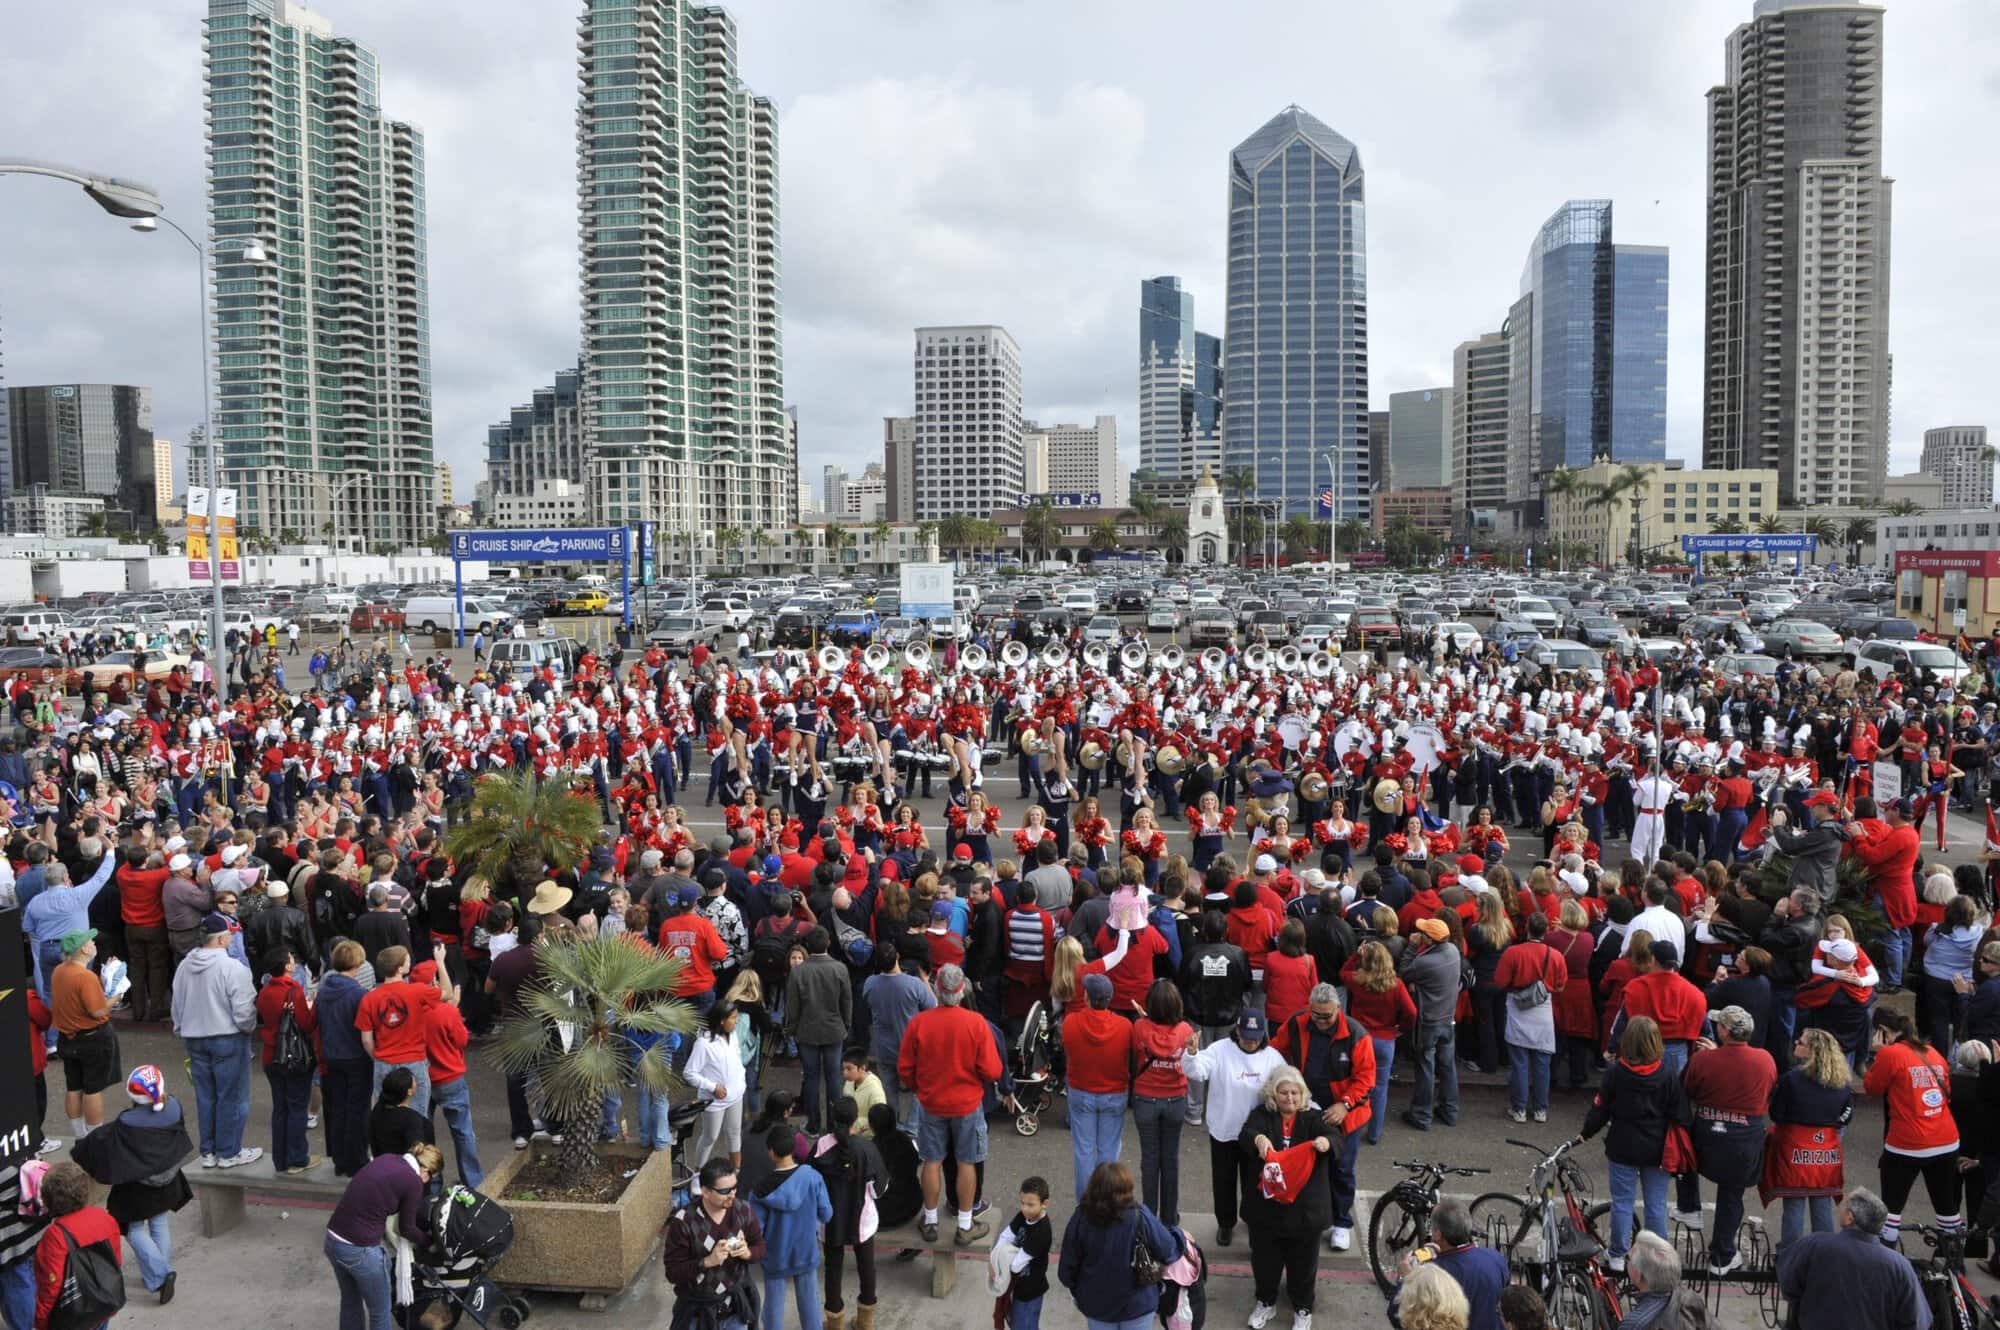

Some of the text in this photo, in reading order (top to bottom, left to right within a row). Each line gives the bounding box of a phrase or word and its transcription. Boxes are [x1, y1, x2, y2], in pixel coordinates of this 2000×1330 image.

[1021, 493, 1098, 506] Santa Fe
[458, 535, 467, 549] 5
[472, 538, 606, 552] CRUISE SHIP PARKING
[611, 533, 621, 547] 5
[1697, 539, 1802, 547] CRUISE SHIP PARKING
[1941, 559, 1980, 567] INFORMATION
[645, 566, 652, 579] P
[0, 1124, 30, 1158] 111
[1791, 1148, 1841, 1165] ARIZONA
